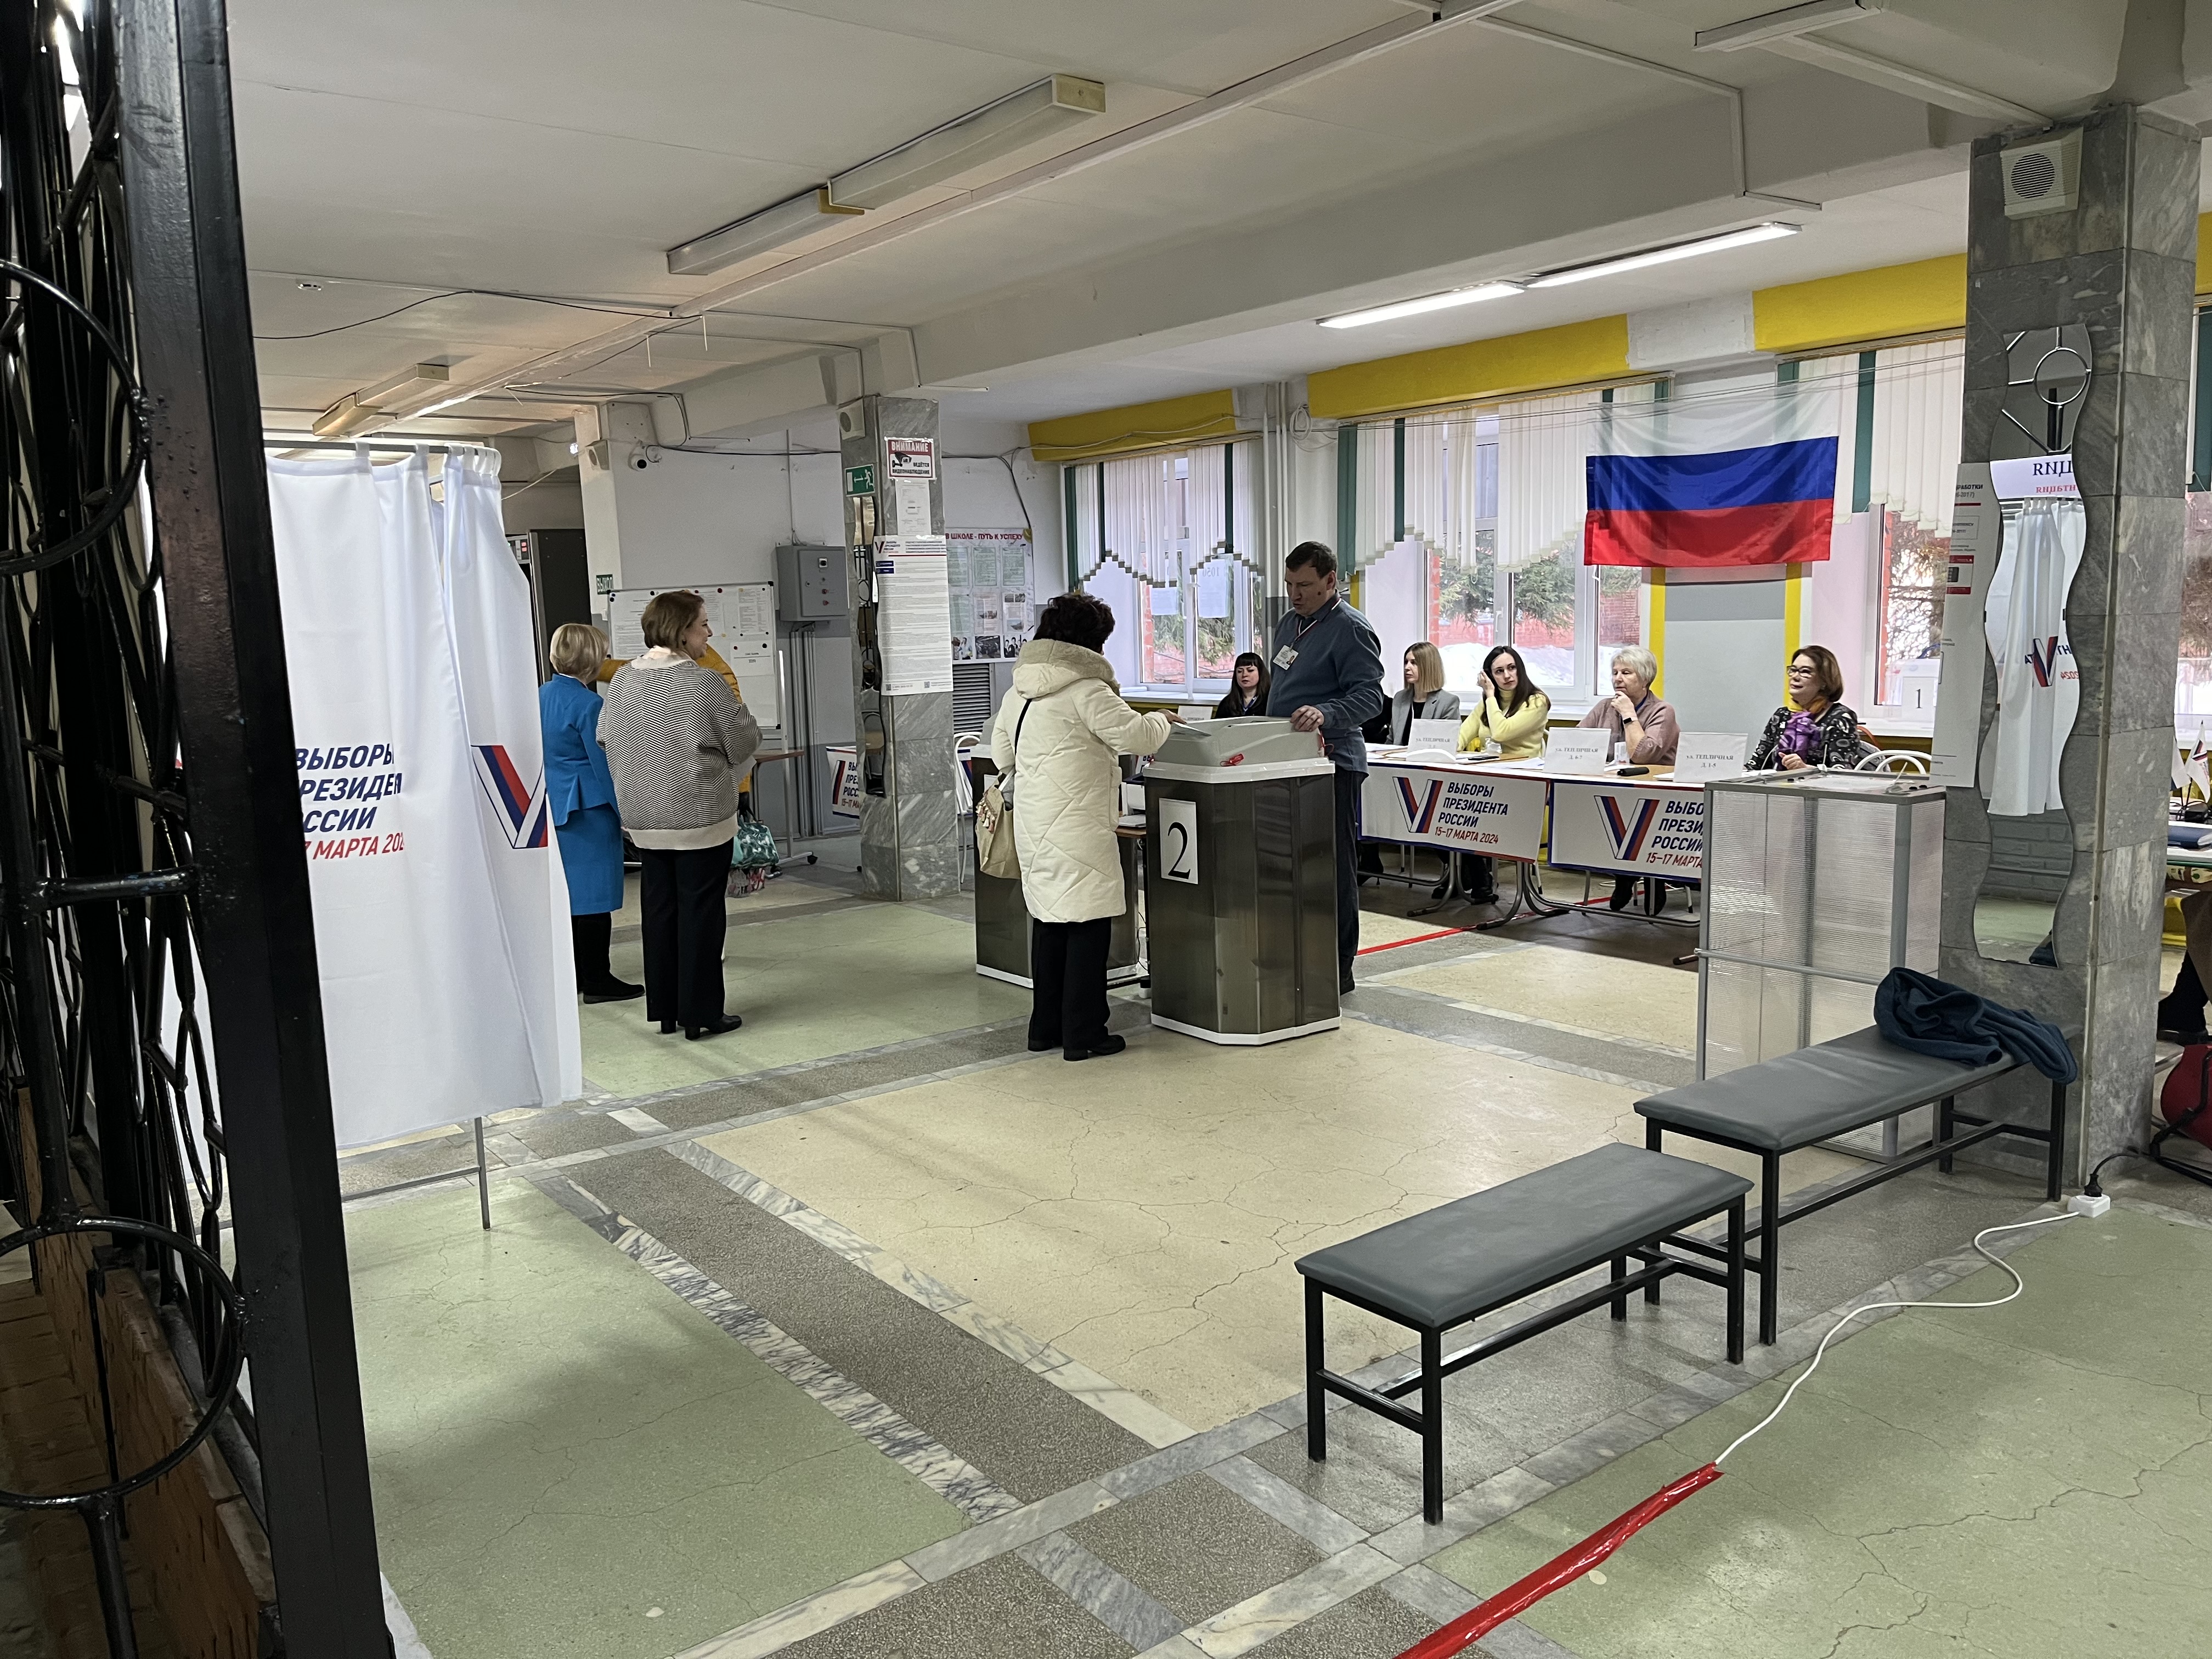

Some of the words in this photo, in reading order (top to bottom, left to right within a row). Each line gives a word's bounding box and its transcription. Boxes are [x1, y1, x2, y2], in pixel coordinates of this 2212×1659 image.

[891, 441, 928, 452] ВНИМАНИЕ
[1916, 689, 1922, 709] 1
[300, 772, 402, 802] РЕЗИДЕН
[843, 786, 859, 798] РОСС
[1447, 782, 1494, 798] ВЫБОРЫ
[1443, 797, 1508, 815] ПРЕЗИДЕНТА
[302, 806, 377, 833] ССИИ
[1438, 812, 1479, 828] РОССИИ
[1658, 818, 1703, 836] ПРЕЗИ
[1454, 829, 1479, 842] МАРТА
[1479, 833, 1499, 844] 2024
[313, 836, 379, 860] МАРТА
[1168, 822, 1190, 879] 2
[1672, 854, 1702, 868] МАРТА
